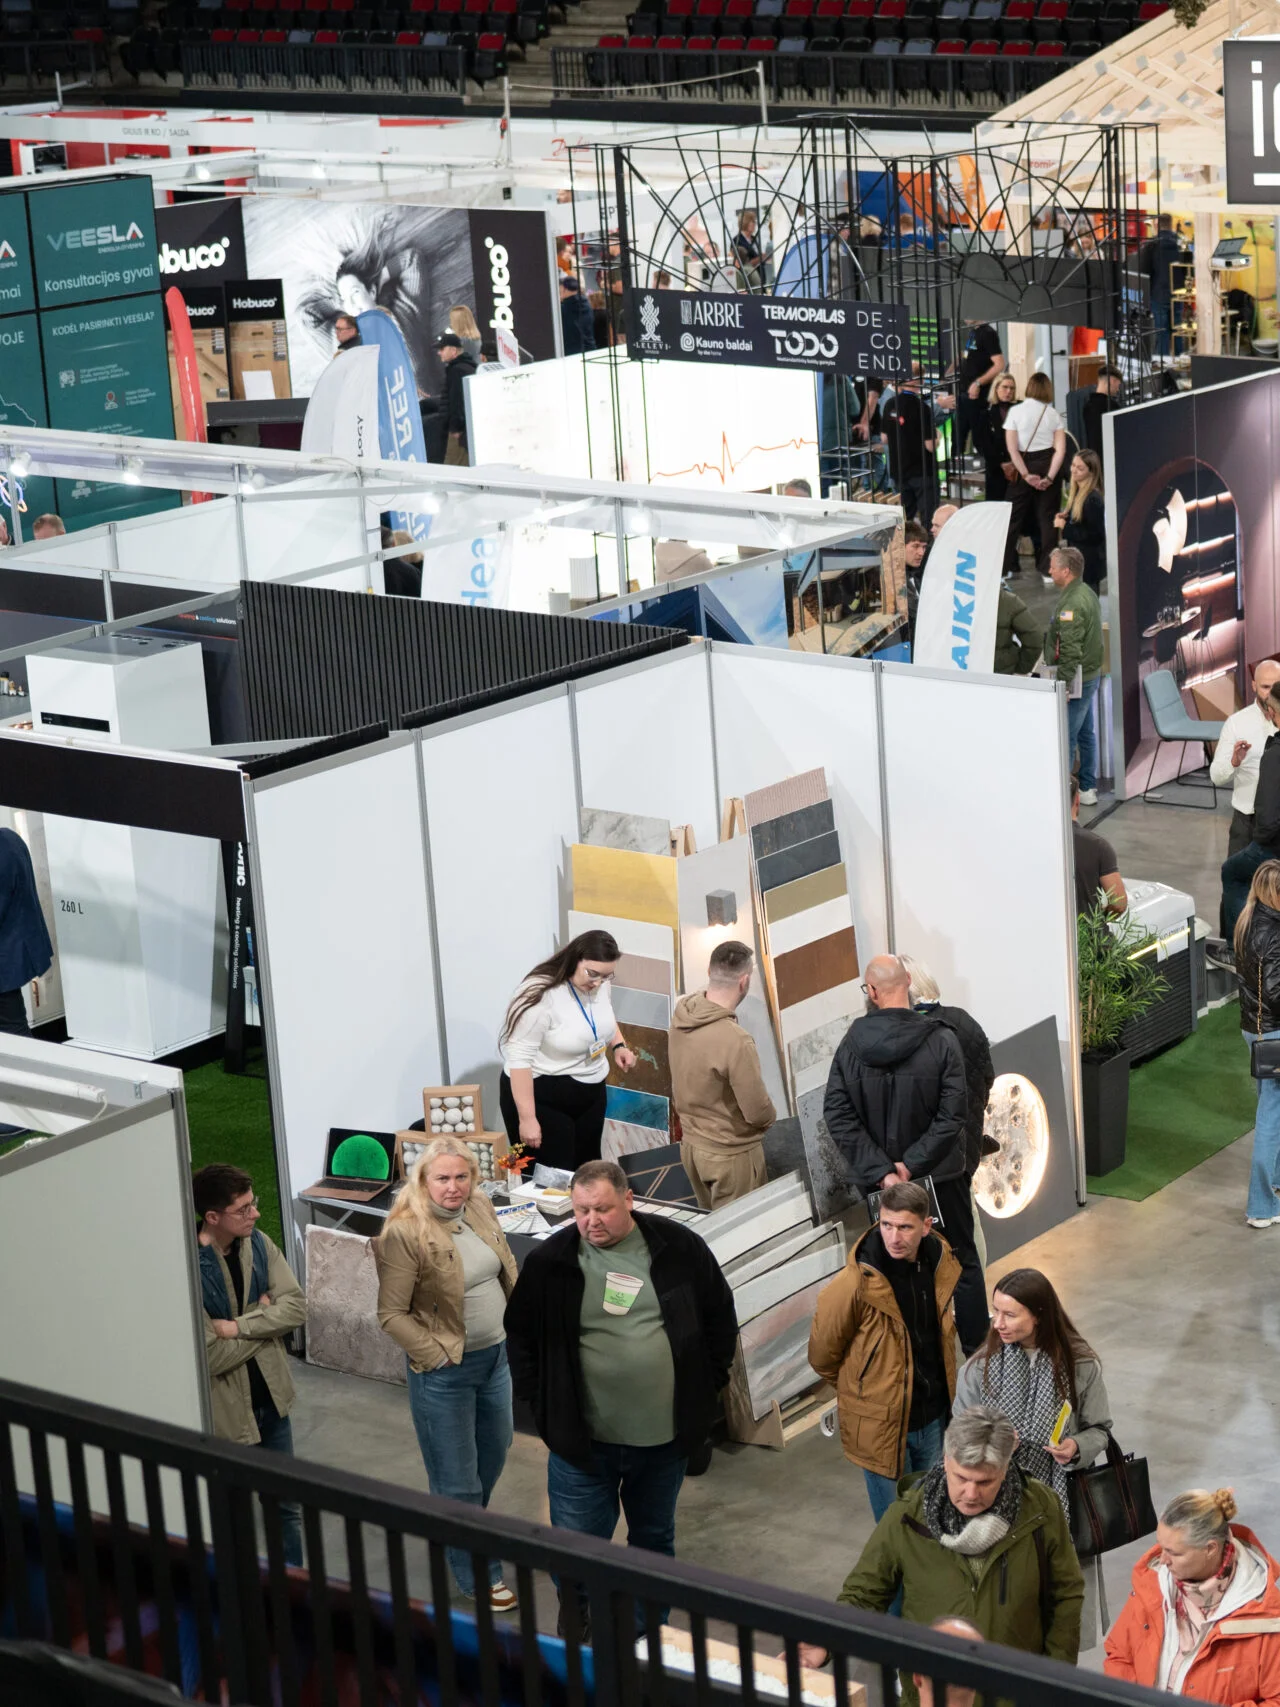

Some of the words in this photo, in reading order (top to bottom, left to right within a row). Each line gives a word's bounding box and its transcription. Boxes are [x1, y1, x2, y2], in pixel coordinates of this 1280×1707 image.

[47, 221, 144, 251] VEESLA
[159, 242, 226, 275] buco
[44, 271, 121, 293] Konsultacijos
[123, 264, 154, 284] gyvai
[488, 243, 514, 337] buco
[187, 305, 215, 317] buco
[232, 297, 275, 309] Hobuco
[693, 301, 744, 328] ARBRE
[761, 304, 846, 325] TERMOPALAS
[52, 323, 78, 336] KODĖL
[79, 317, 122, 332] PASIRINKTI
[123, 311, 155, 325] VEESLA?
[696, 337, 724, 349] Kauno
[726, 339, 753, 351] baldai
[768, 329, 839, 358] TODO
[870, 333, 901, 351] CO
[461, 537, 497, 607] dea
[951, 549, 977, 670] AIKIN
[61, 899, 76, 913] 260
[78, 901, 84, 914] L
[234, 897, 242, 925] heating
[232, 931, 240, 956] cooling
